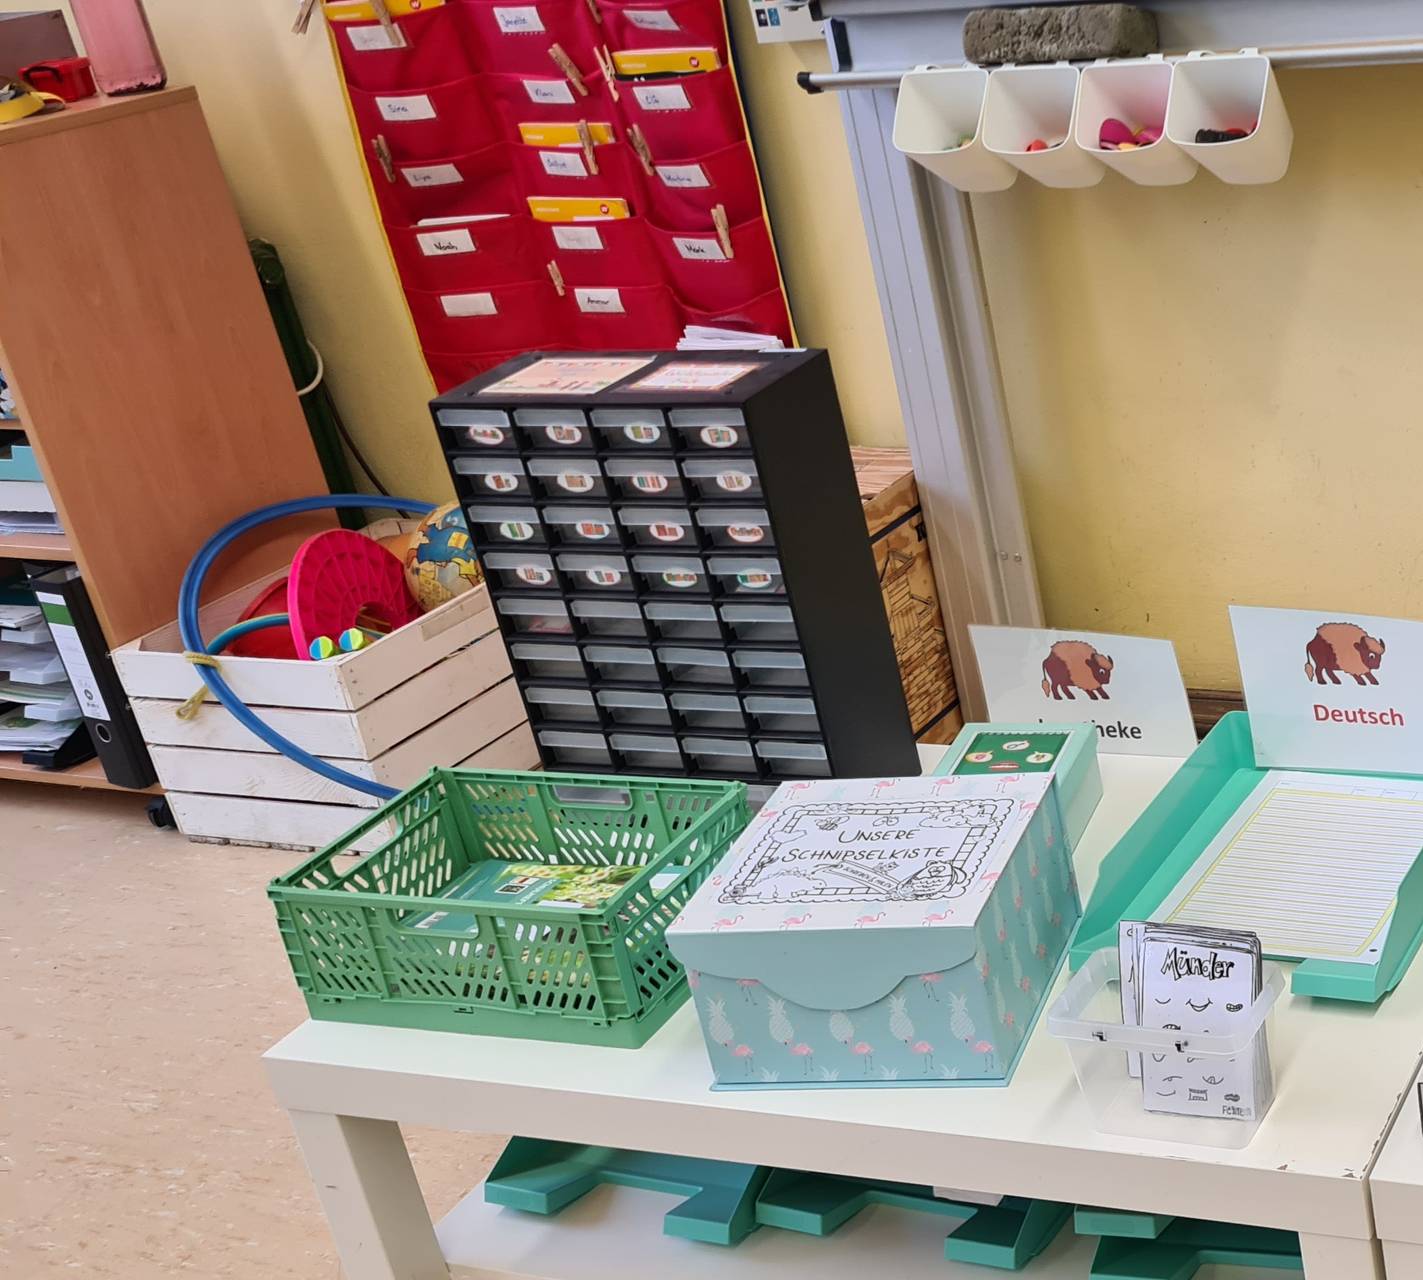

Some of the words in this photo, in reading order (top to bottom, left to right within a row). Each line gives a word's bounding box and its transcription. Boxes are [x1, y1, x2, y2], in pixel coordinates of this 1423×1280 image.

[1313, 702, 1405, 728] Deutsch
[838, 828, 920, 844] UNSERE
[1160, 946, 1236, 982] Münder
